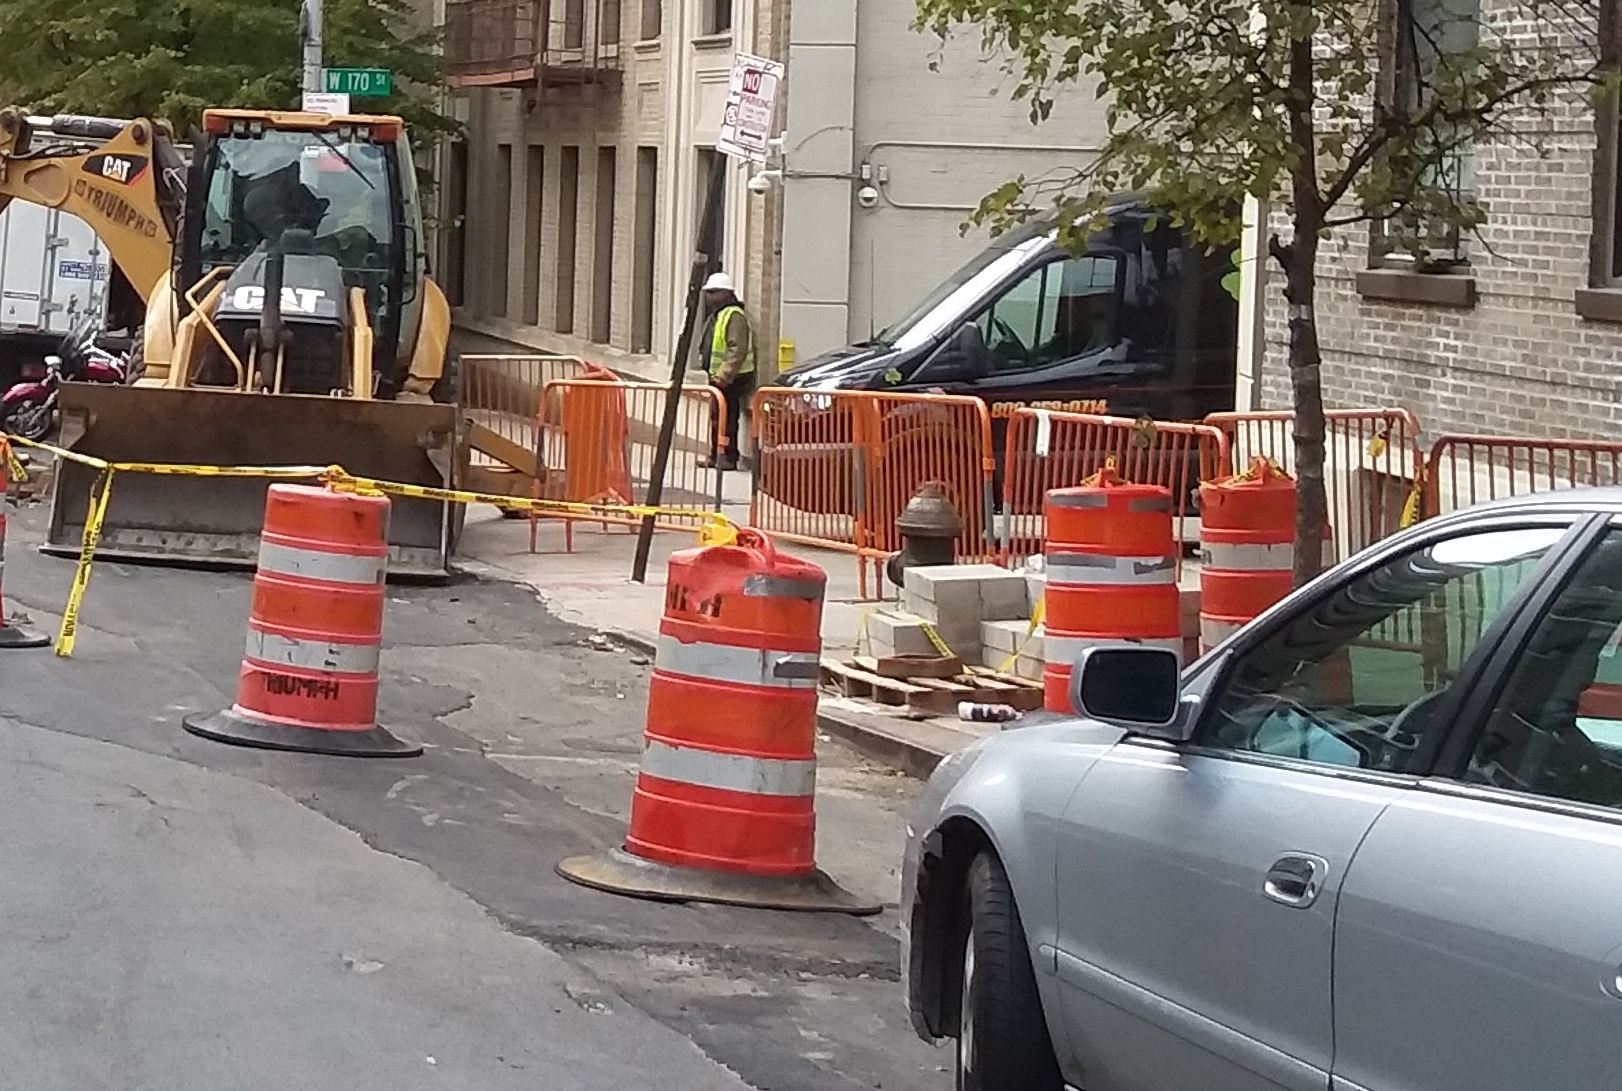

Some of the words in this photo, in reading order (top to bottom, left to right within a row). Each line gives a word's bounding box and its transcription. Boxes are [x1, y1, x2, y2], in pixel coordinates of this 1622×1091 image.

[329, 71, 341, 90] W
[347, 72, 369, 91] 170
[375, 73, 386, 86] St
[743, 73, 760, 92] NO
[102, 155, 132, 182] CAT
[86, 185, 146, 233] TRIUMPH
[232, 285, 325, 313] CAT
